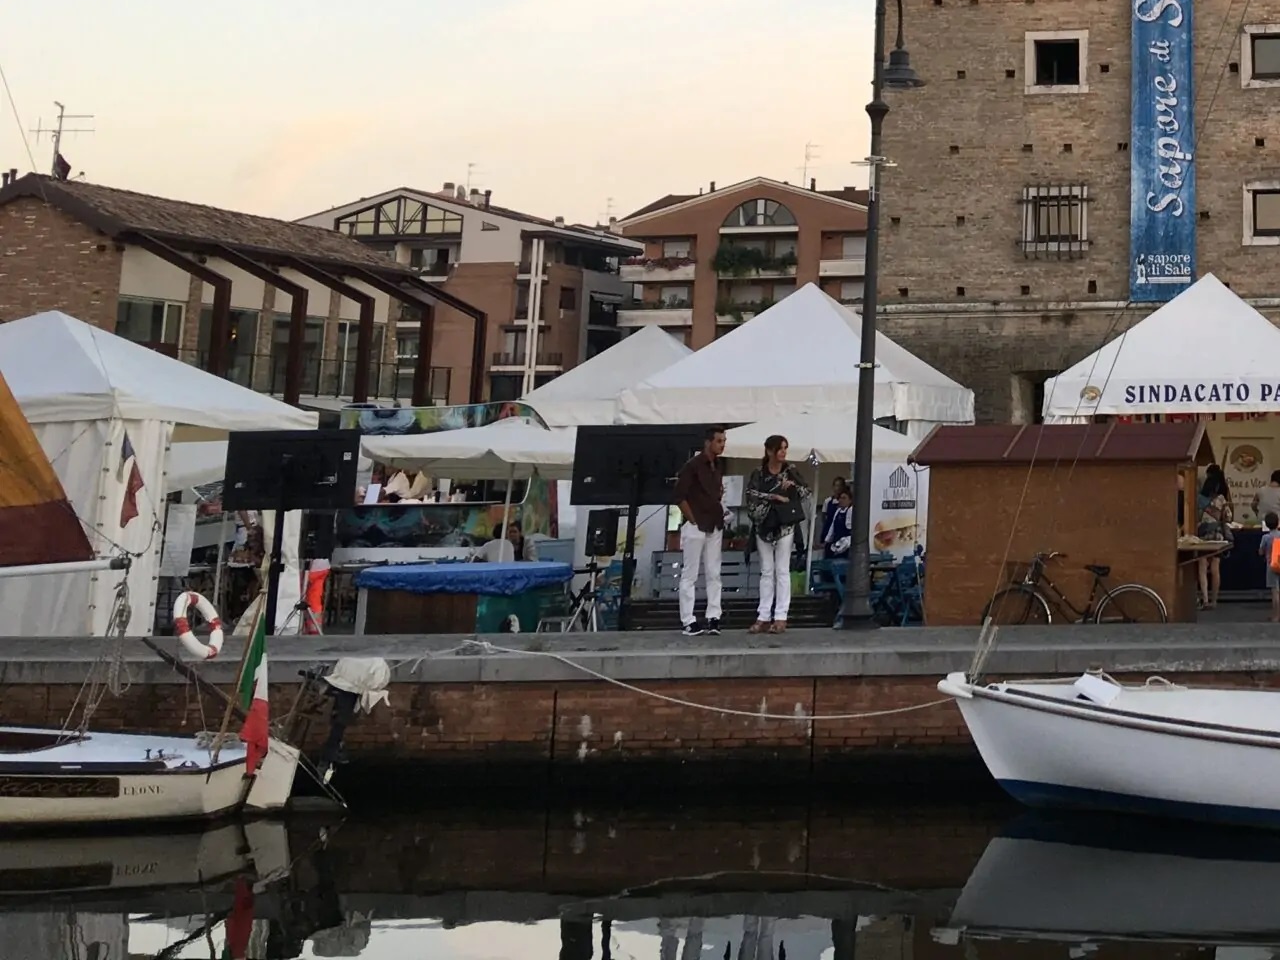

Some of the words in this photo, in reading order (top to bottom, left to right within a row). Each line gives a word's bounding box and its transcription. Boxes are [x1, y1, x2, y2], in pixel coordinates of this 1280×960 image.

[1149, 39, 1170, 63] di
[1146, 73, 1193, 217] Sapore
[1147, 253, 1191, 266] sapore
[1164, 262, 1192, 276] Sale
[1124, 383, 1250, 404] SINDACATO
